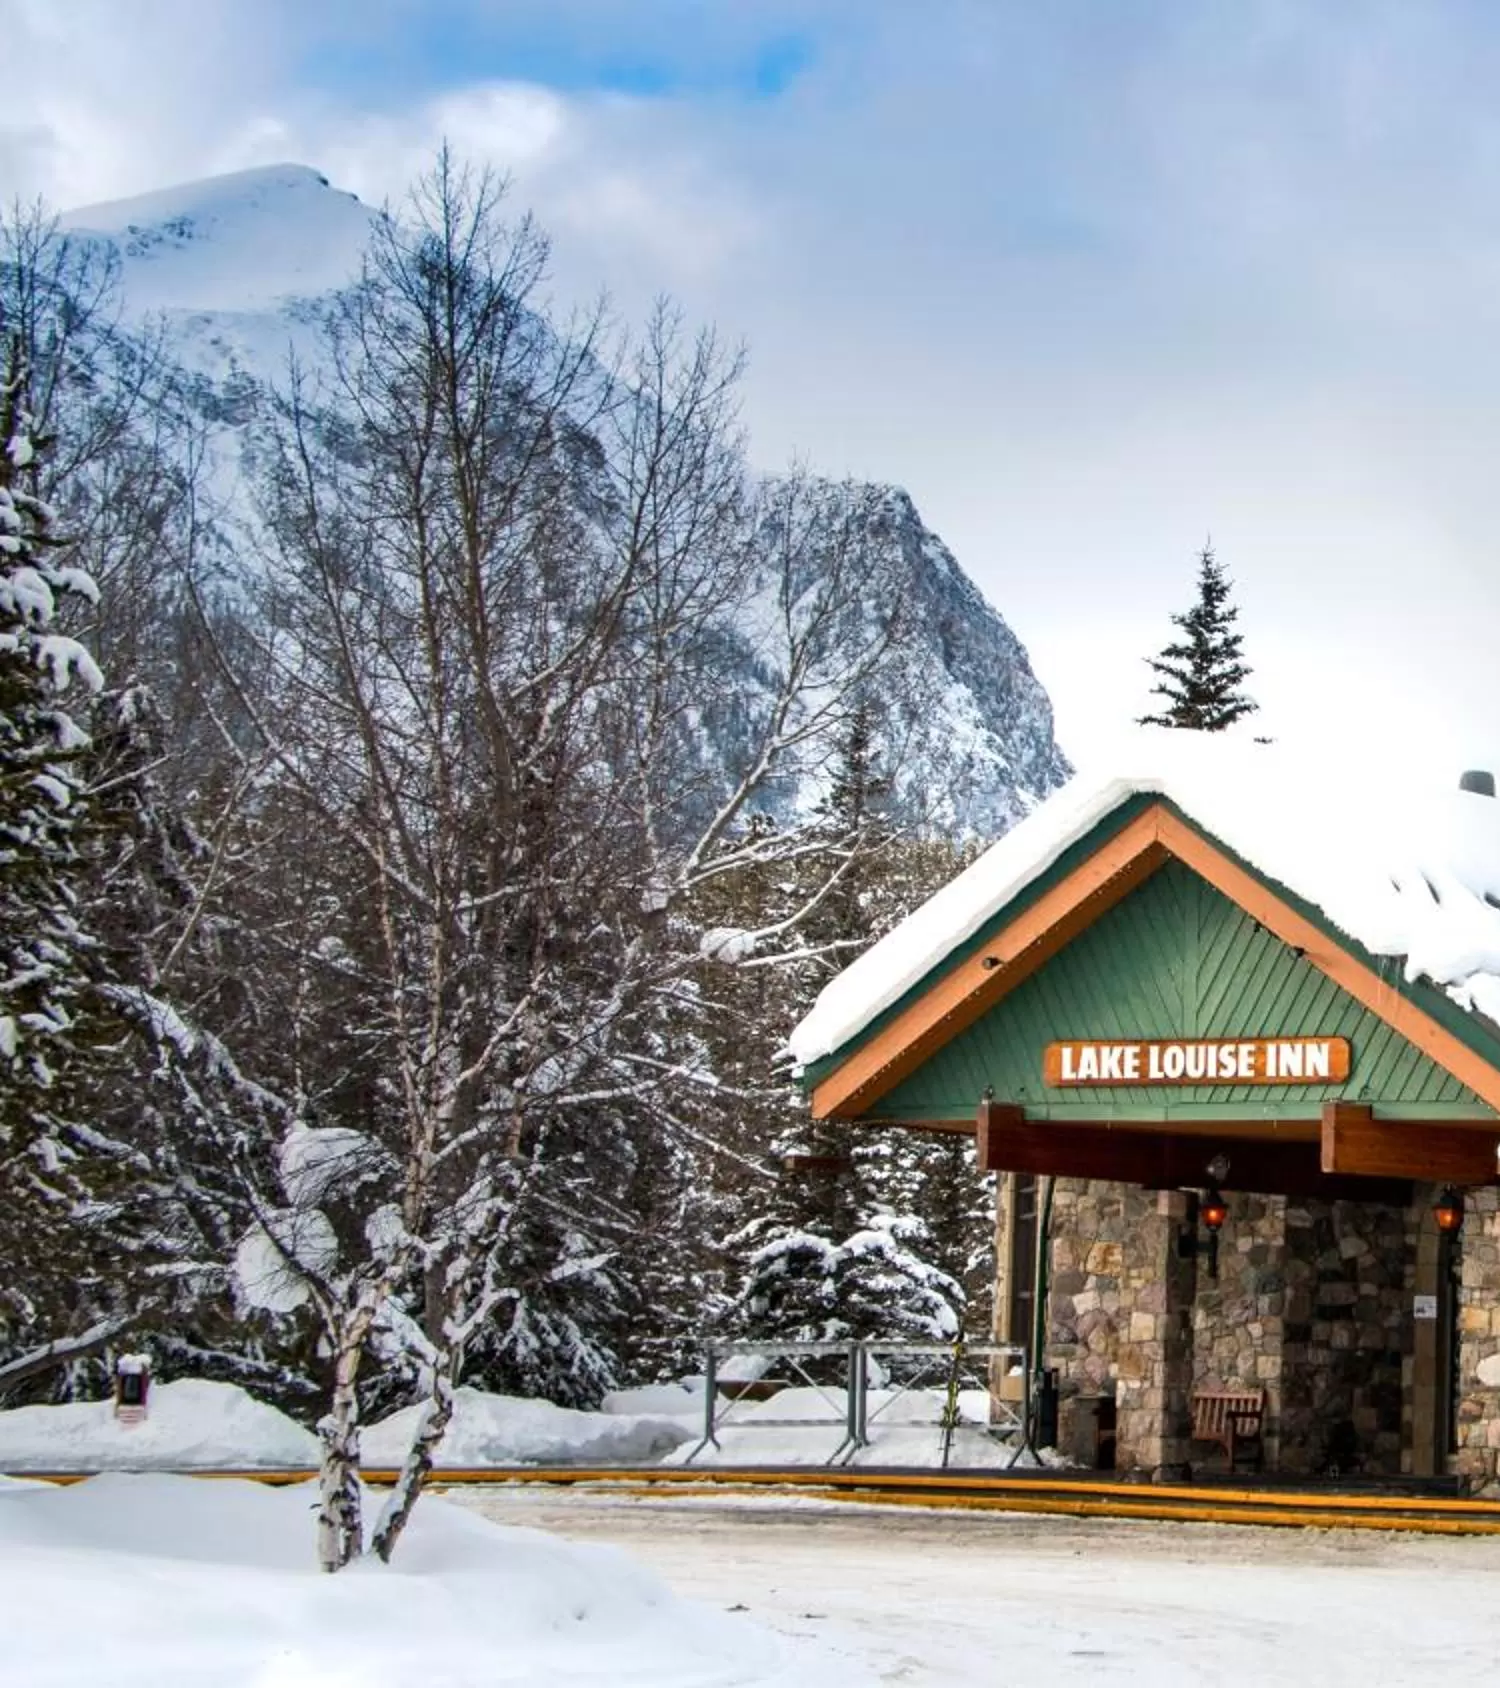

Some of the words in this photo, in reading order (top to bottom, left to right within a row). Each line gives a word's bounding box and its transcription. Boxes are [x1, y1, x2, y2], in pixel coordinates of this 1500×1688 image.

[1061, 1046, 1140, 1080] LAKE
[1149, 1044, 1255, 1079] LOUISE
[1265, 1042, 1330, 1077] INN
